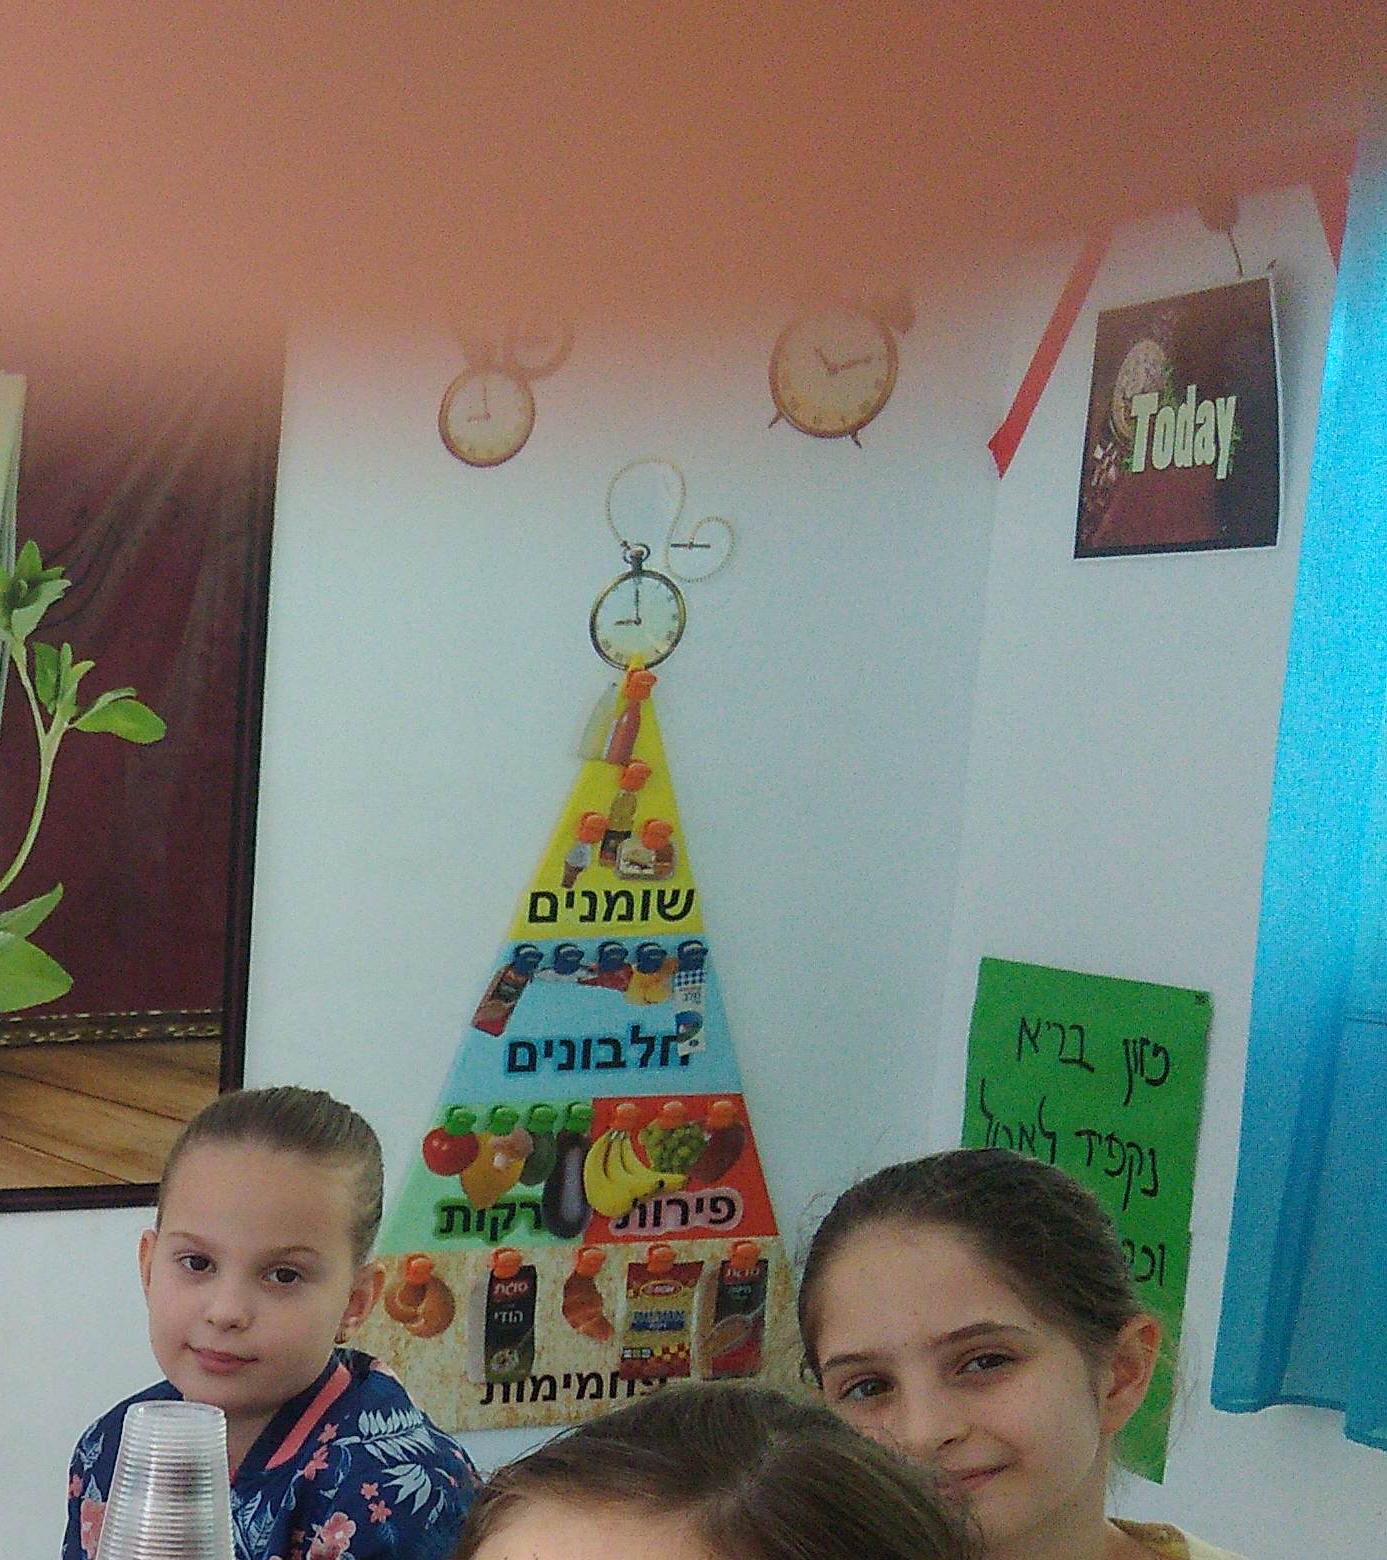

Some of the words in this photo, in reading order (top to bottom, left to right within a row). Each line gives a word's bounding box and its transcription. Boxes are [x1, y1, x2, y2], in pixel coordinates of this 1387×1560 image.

[1131, 384, 1237, 480] Today
[527, 886, 697, 924] שומנים
[507, 1024, 690, 1074] חלבונים
[1016, 1016, 1095, 1073] בריא
[1074, 1127, 1161, 1212] נקפיד
[439, 1201, 543, 1243] רקות
[614, 1196, 737, 1230] פירות
[480, 1371, 668, 1405] חמימות
